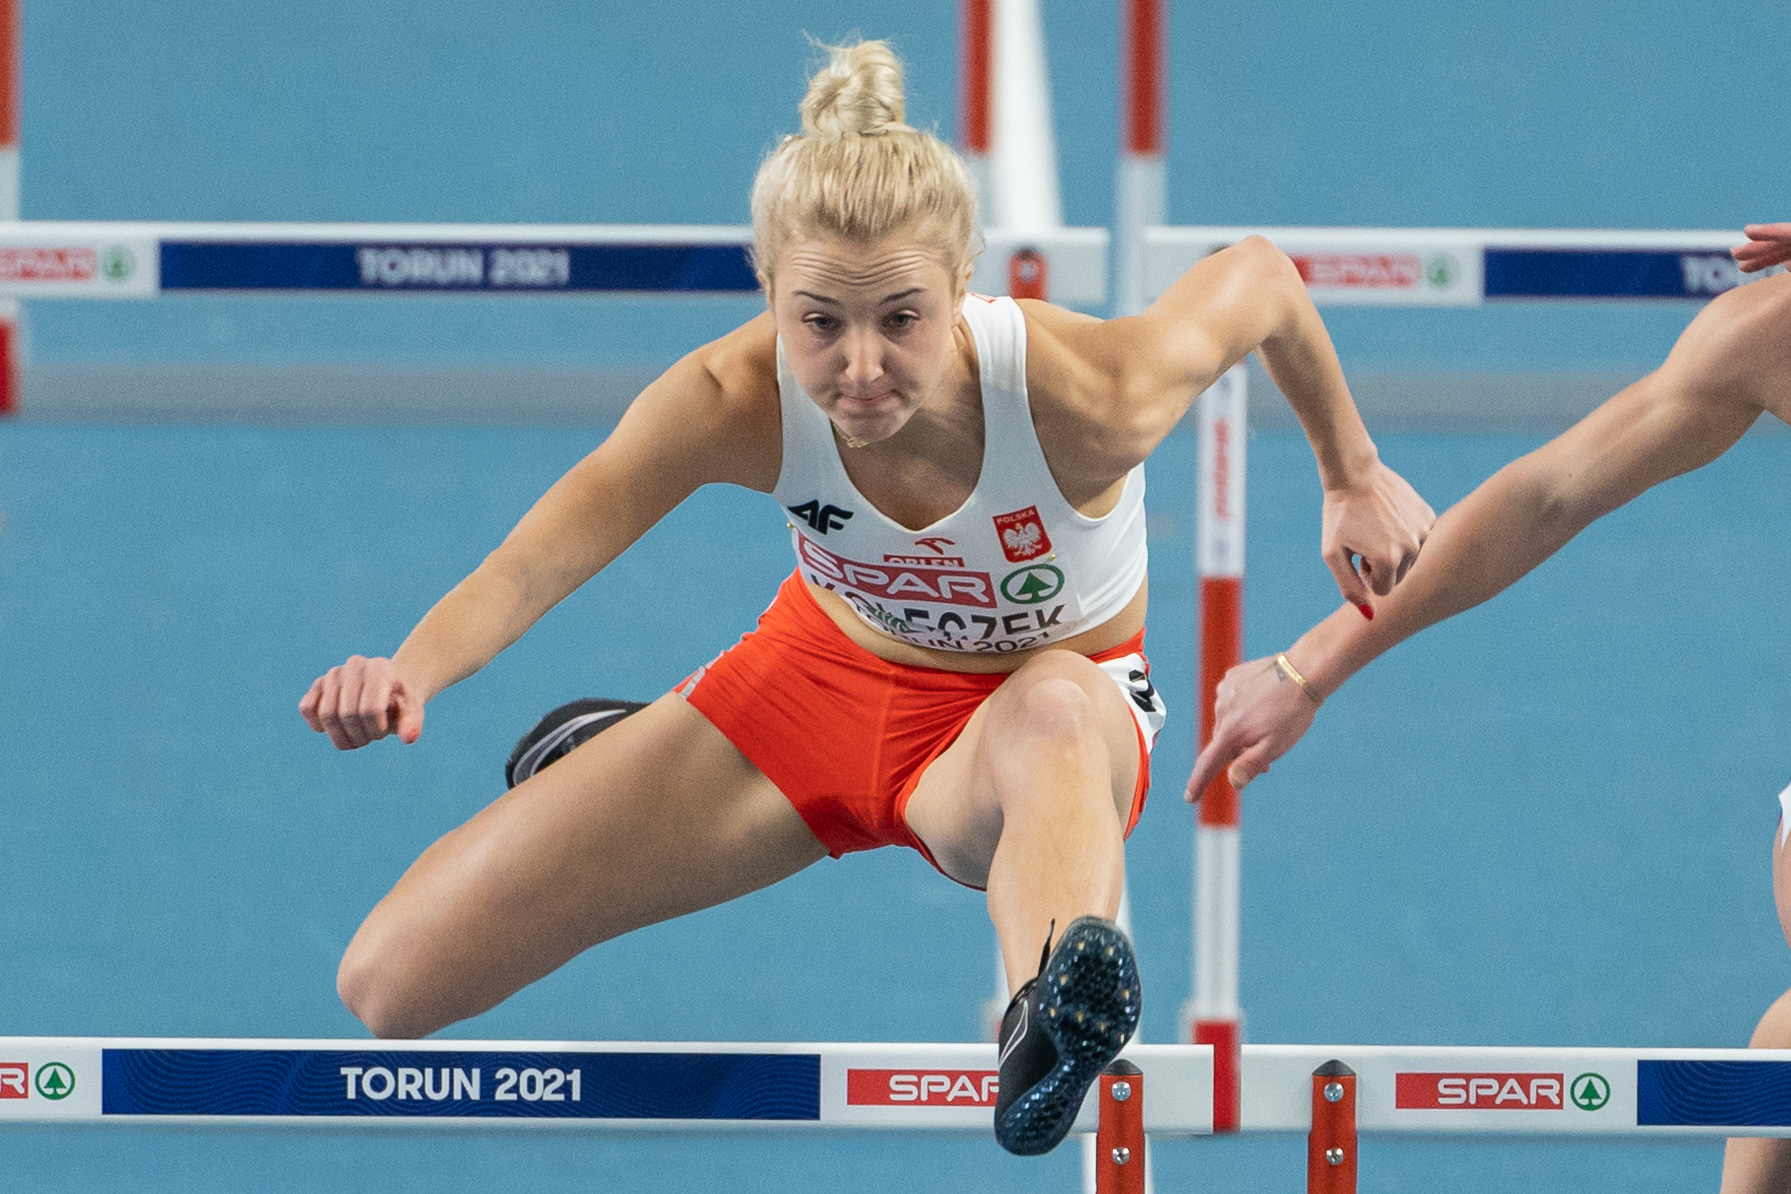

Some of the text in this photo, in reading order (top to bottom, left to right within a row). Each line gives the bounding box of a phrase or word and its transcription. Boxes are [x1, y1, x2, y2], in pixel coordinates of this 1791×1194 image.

[357, 248, 484, 285] TORUN
[996, 509, 1035, 524] POLSKA
[802, 541, 990, 603] SPAR
[340, 1066, 581, 1101] TORUN 2021
[1437, 1077, 1561, 1105] SPAR
